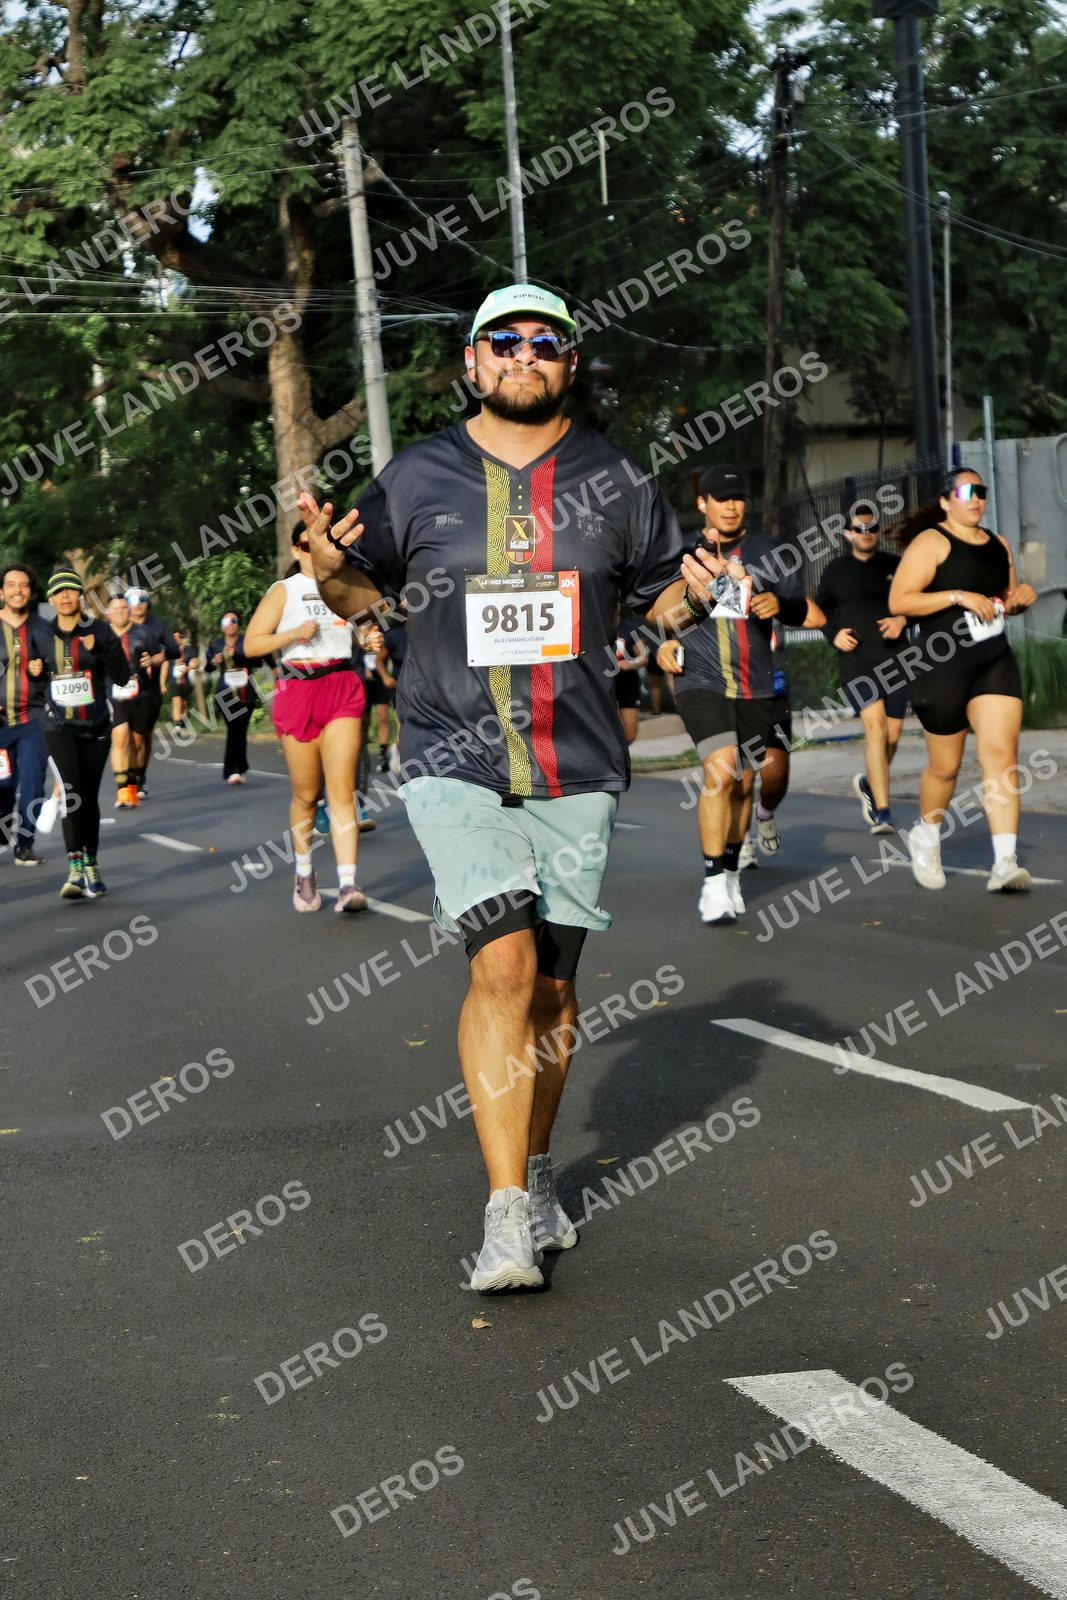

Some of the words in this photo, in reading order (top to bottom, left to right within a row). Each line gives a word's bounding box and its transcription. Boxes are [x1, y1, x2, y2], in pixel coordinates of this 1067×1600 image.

[306, 604, 335, 616] 103
[481, 602, 555, 634] 9815
[55, 681, 89, 695] 12090
